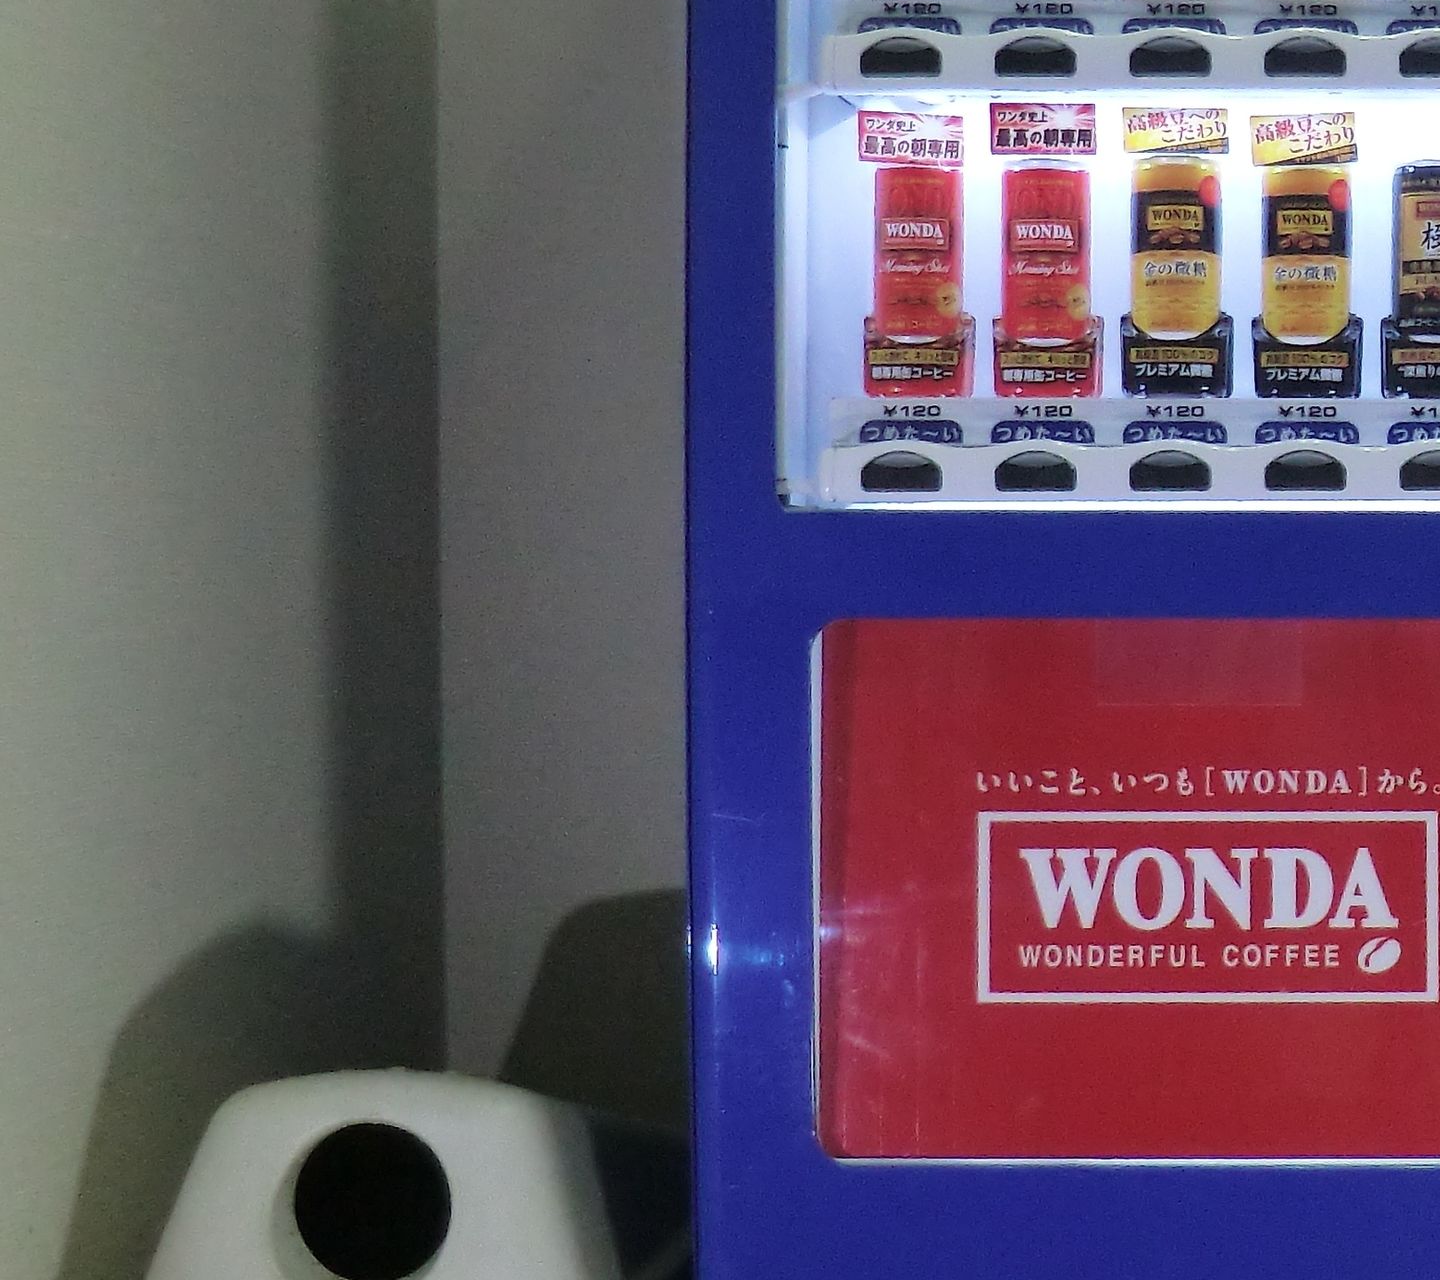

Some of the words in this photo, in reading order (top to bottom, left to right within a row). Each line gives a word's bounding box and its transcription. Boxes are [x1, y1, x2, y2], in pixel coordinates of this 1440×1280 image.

[866, 118, 917, 133] ワンダ史上
[996, 111, 1050, 124] ワンダ史上
[995, 127, 1093, 150] 最高の朝専用
[1161, 120, 1229, 144] こだわり
[1288, 127, 1356, 154] こだわり
[863, 135, 961, 160] 最高の朝専用
[1152, 208, 1200, 224] WONDA
[1281, 213, 1329, 227] WONDA
[884, 222, 944, 240] WONDA
[1015, 222, 1075, 240] WONDA
[1143, 260, 1208, 279] 金の微糖
[1273, 264, 1338, 283] 金の微糖
[1019, 847, 1399, 931] WONDA
[1019, 943, 1205, 970] WONDERFUL
[1221, 943, 1341, 970] COFFEE
